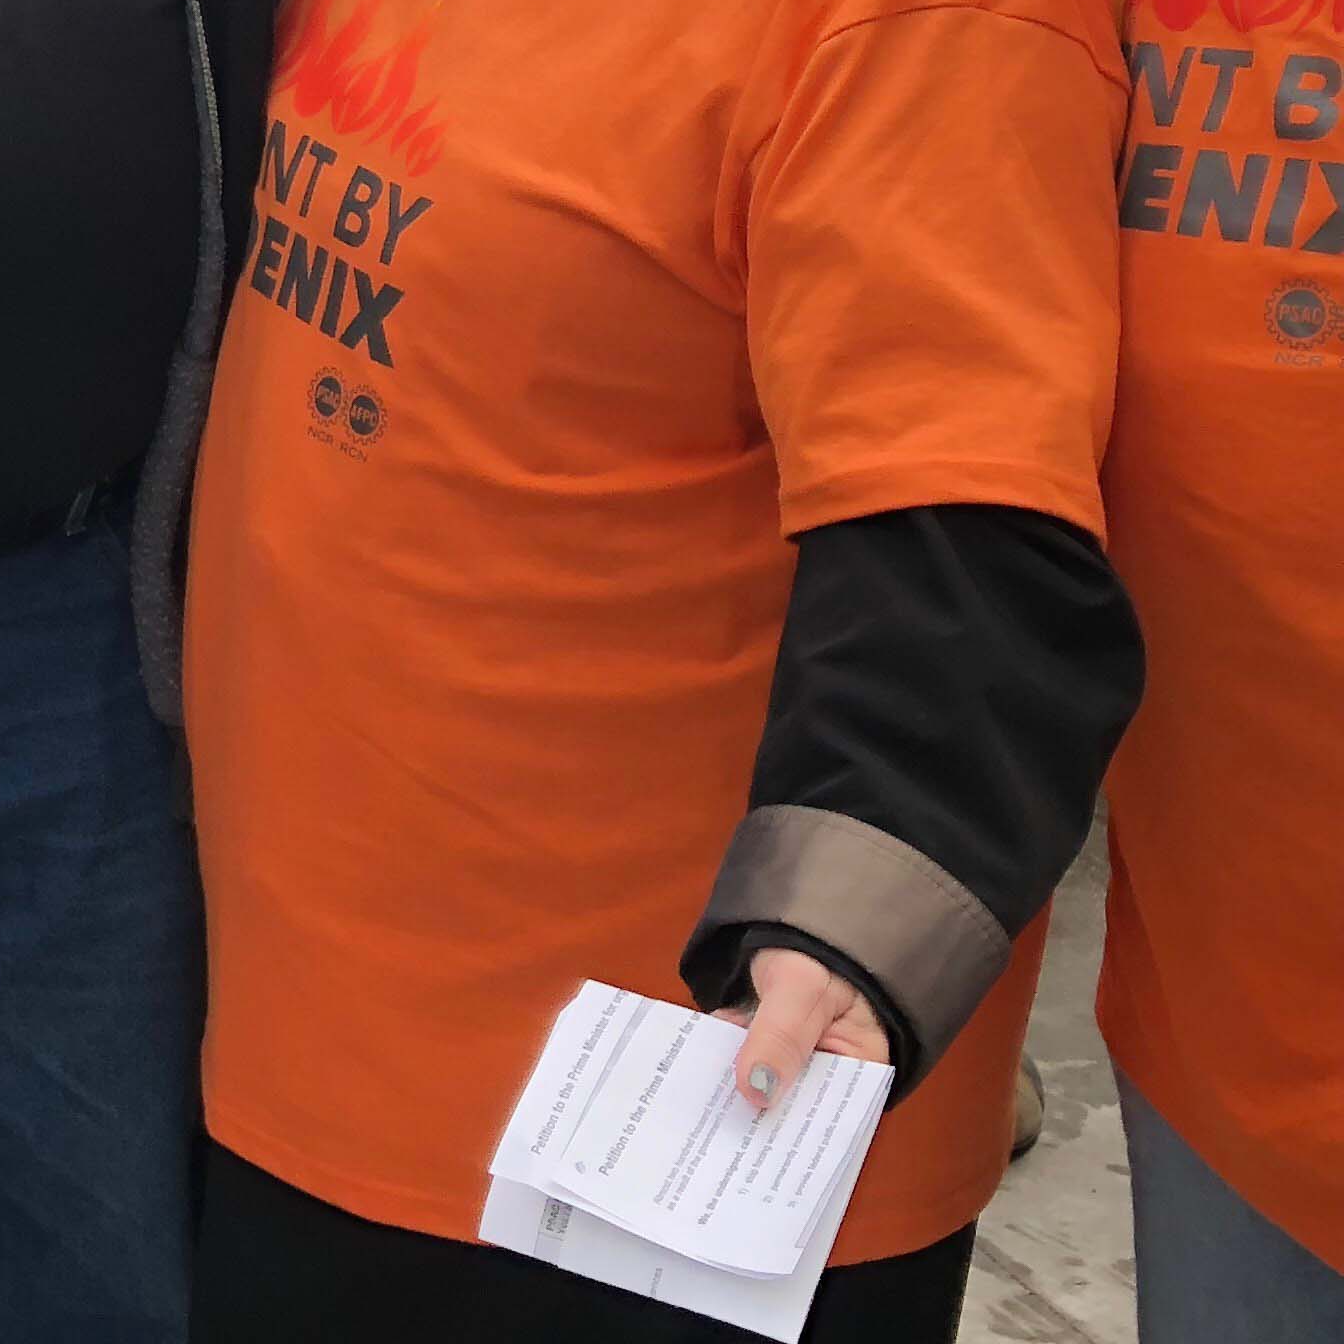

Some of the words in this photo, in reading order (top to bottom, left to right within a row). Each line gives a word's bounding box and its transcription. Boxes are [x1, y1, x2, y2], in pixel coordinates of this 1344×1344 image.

[1130, 41, 1255, 133] NT
[261, 119, 338, 218] NT
[333, 165, 435, 266] BY
[1119, 142, 1344, 256] ENIX
[249, 215, 405, 369] ENIX
[531, 1114, 559, 1154] Petition
[553, 1100, 565, 1112] to
[559, 1081, 574, 1099] the
[568, 1052, 590, 1081] Prime
[584, 1016, 609, 1052] Minister
[603, 1002, 617, 1017] for
[599, 1134, 630, 1176] Petition
[622, 1122, 636, 1135] to
[630, 1104, 646, 1123] the
[640, 1075, 662, 1104] Prime
[657, 1033, 686, 1074] Minister
[679, 1019, 694, 1034] for
[706, 1197, 718, 1210] the
